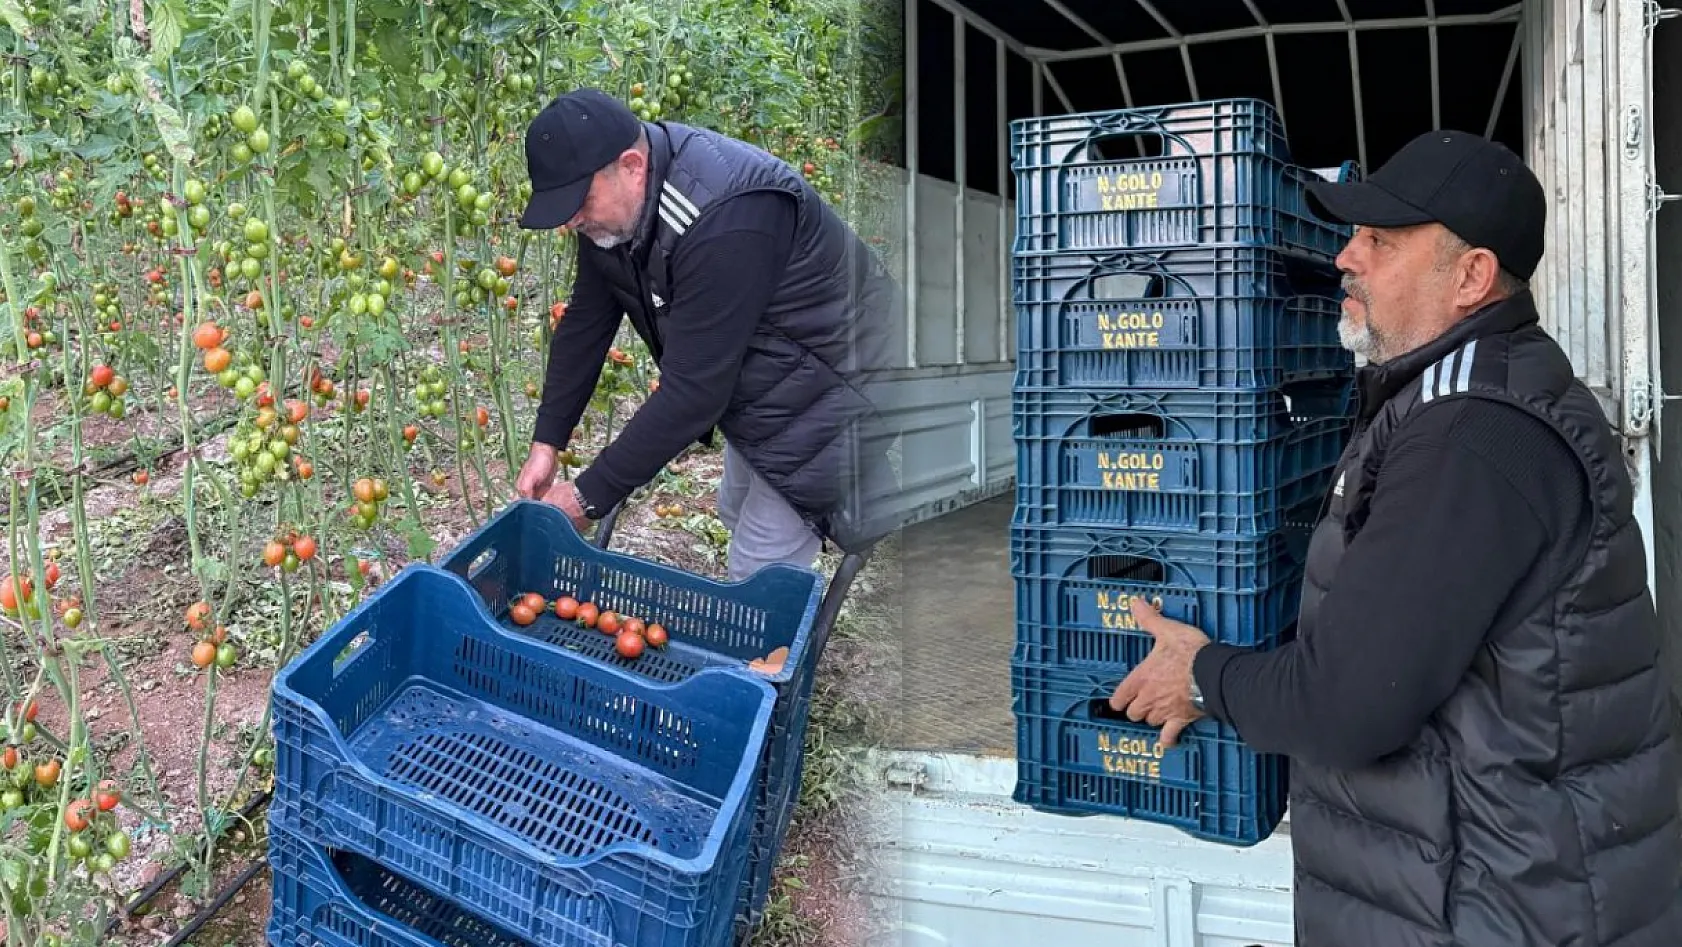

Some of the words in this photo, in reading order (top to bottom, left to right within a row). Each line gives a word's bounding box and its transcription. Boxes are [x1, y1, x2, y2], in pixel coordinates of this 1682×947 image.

[1097, 172, 1162, 193] N.GOLO
[1102, 192, 1158, 210] KANTE
[1097, 312, 1164, 330] N.GOLO
[1102, 332, 1159, 349] KANTE
[1097, 452, 1164, 469] N.GOLO
[1102, 472, 1160, 490] KANTE
[1097, 592, 1163, 612] N.GO
[1102, 612, 1142, 631] KAN
[1097, 733, 1164, 758] N.GOLO
[1103, 755, 1161, 778] KANTE
